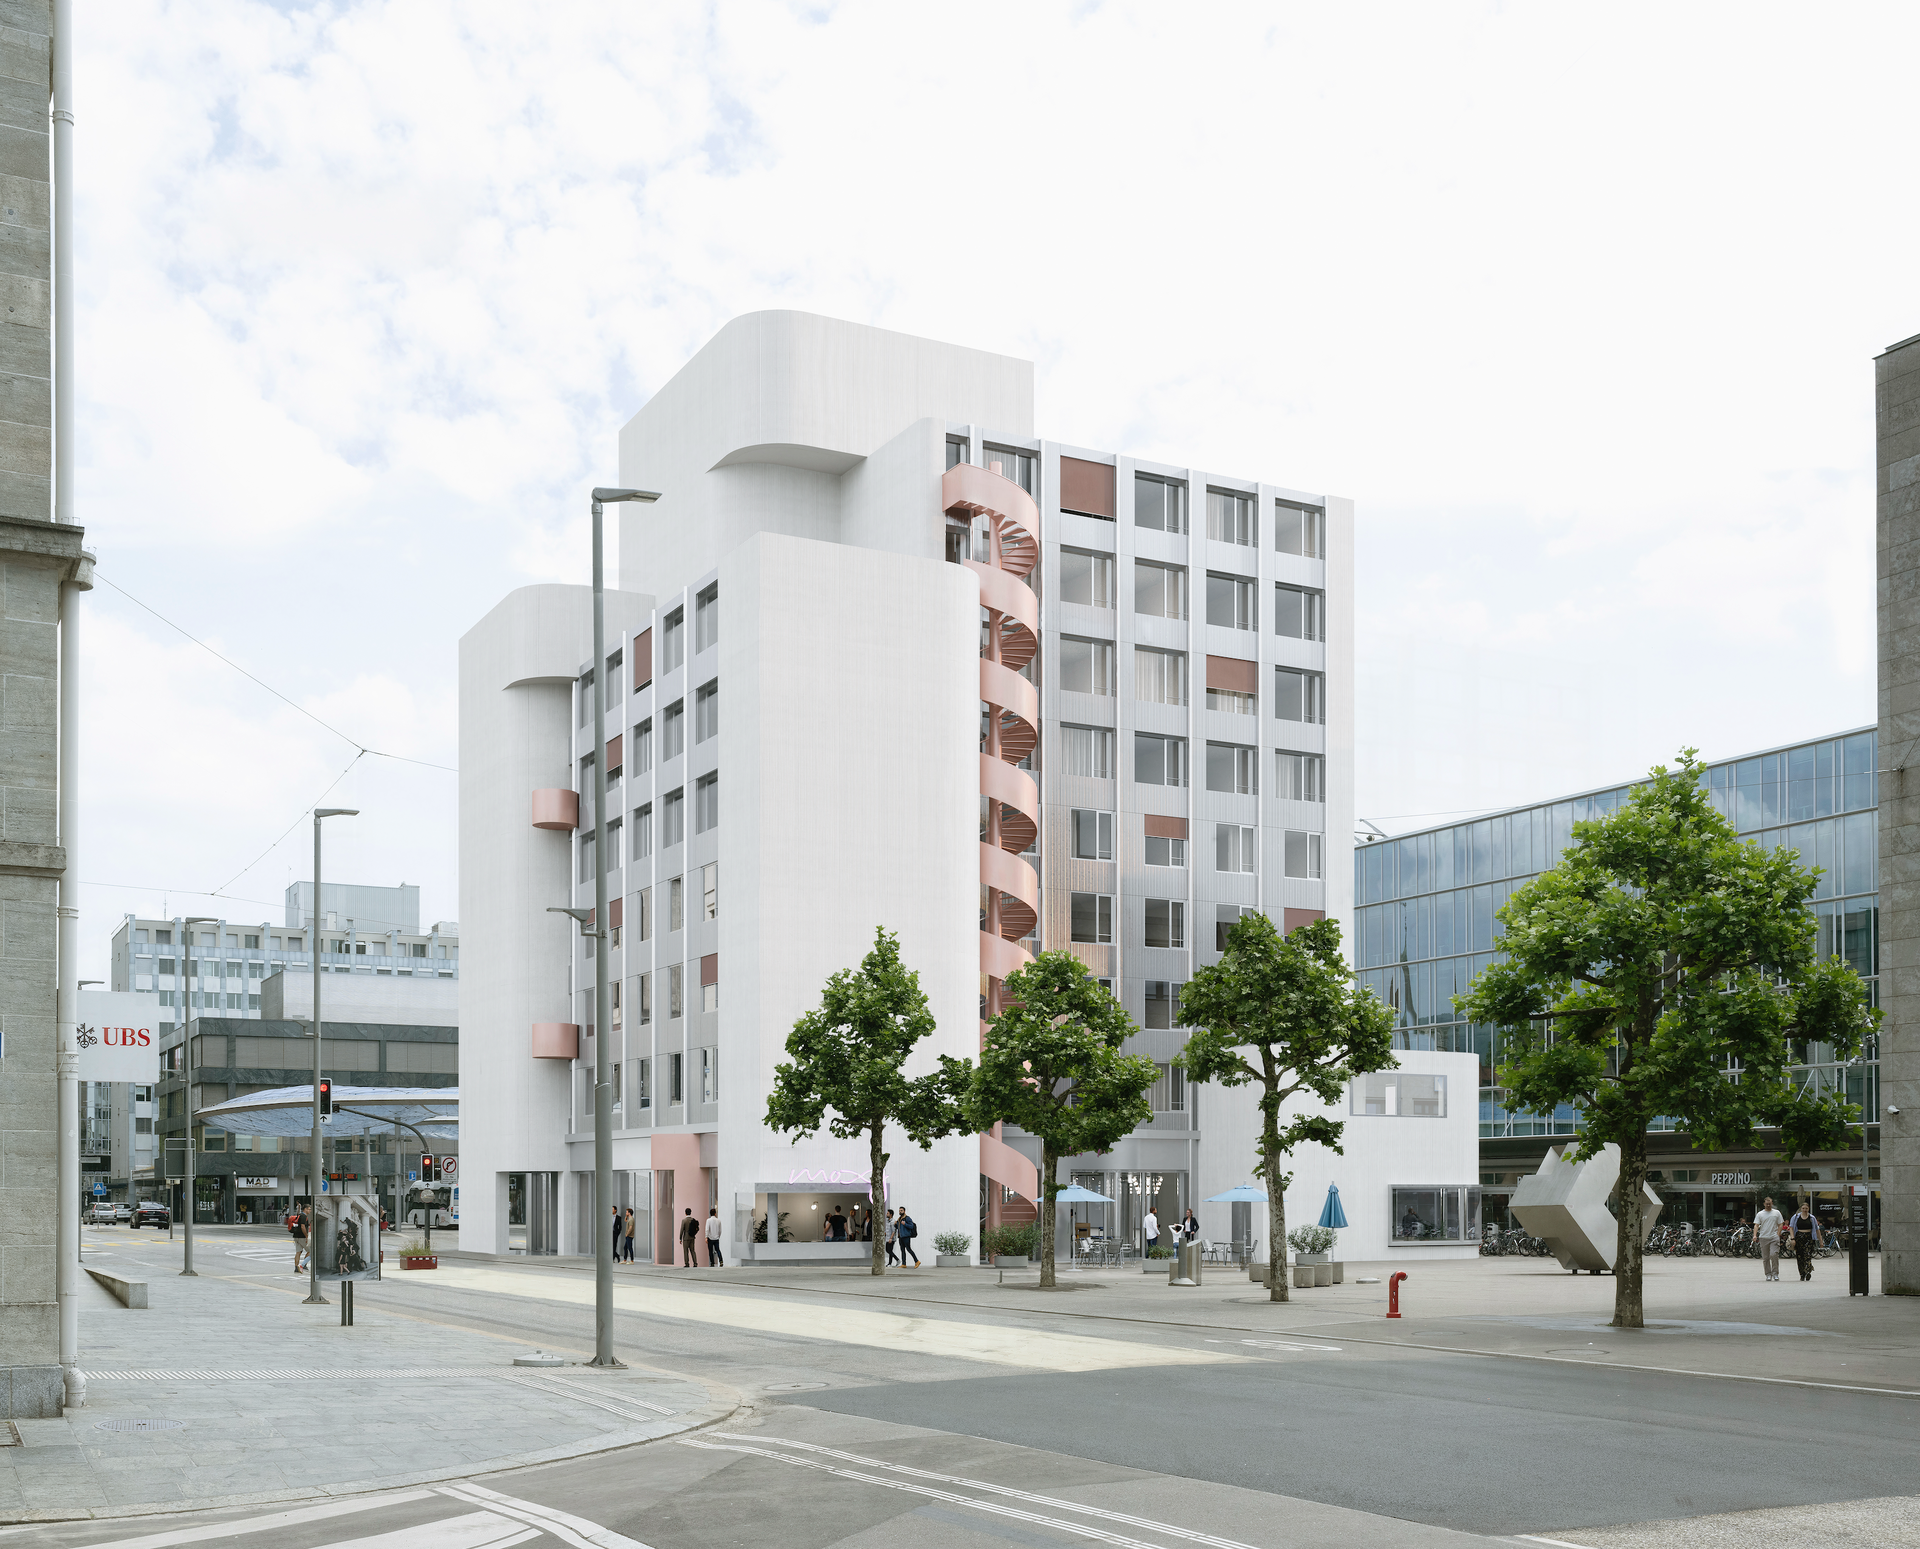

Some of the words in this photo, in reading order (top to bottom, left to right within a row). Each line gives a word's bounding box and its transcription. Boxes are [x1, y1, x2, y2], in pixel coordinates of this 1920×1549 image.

[102, 1027, 151, 1047] UBS
[246, 1177, 270, 1186] MAD
[1711, 1172, 1751, 1185] PEPPINO
